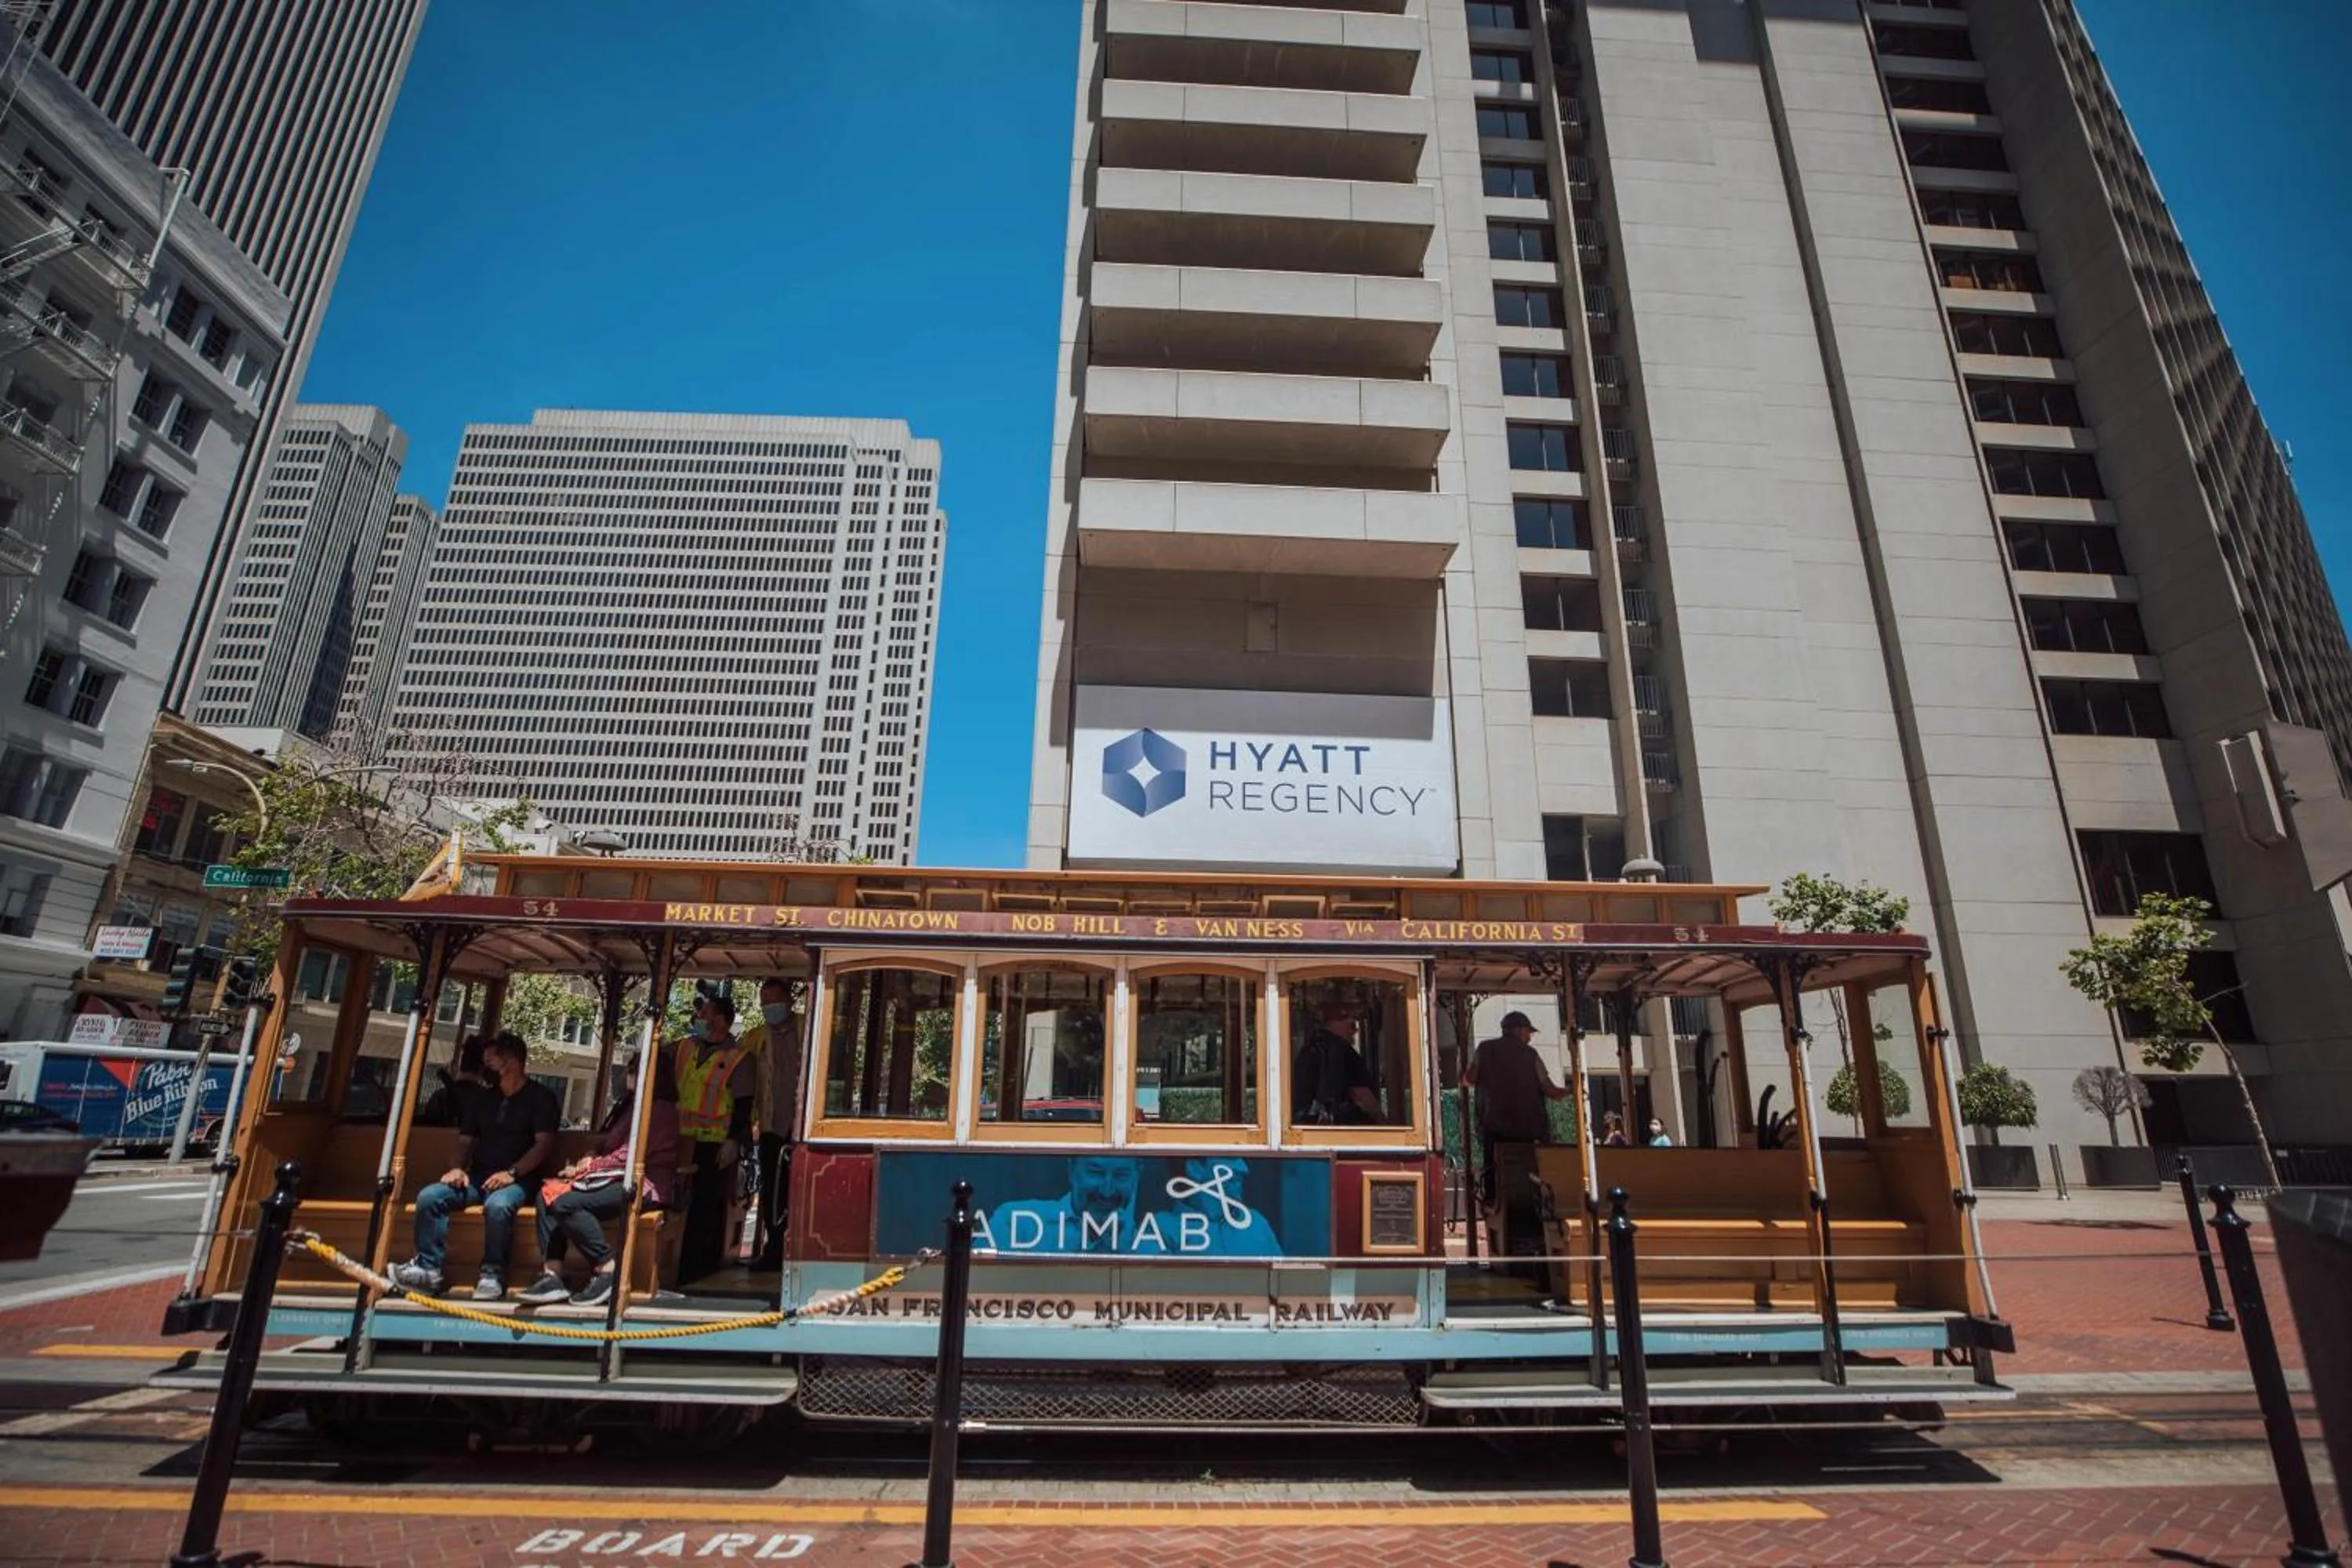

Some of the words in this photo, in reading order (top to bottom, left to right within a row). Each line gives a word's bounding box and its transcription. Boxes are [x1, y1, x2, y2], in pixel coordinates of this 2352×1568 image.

[1210, 741, 1370, 775] HYATT
[1209, 781, 1426, 815] REGENCY
[523, 901, 559, 916] 54
[665, 903, 755, 924] MARKET
[828, 910, 960, 929] CHINATOWN
[1012, 914, 1055, 931] NOB
[1073, 916, 1126, 935] HILL
[1196, 920, 1237, 937] VAN
[1247, 920, 1304, 938] NESS
[1401, 922, 1542, 940] CALIFORNIA
[1674, 926, 1709, 942] 54
[144, 1061, 192, 1091] Pabst
[125, 1094, 163, 1124] Blue
[163, 1078, 219, 1104] Ribon
[971, 1209, 1210, 1251] ADIMAB
[902, 1298, 1076, 1319] FRNCISCO
[1094, 1301, 1250, 1321] MUNICIPAL
[1275, 1302, 1395, 1322] RAILWAY
[514, 1529, 815, 1559] BOARD
